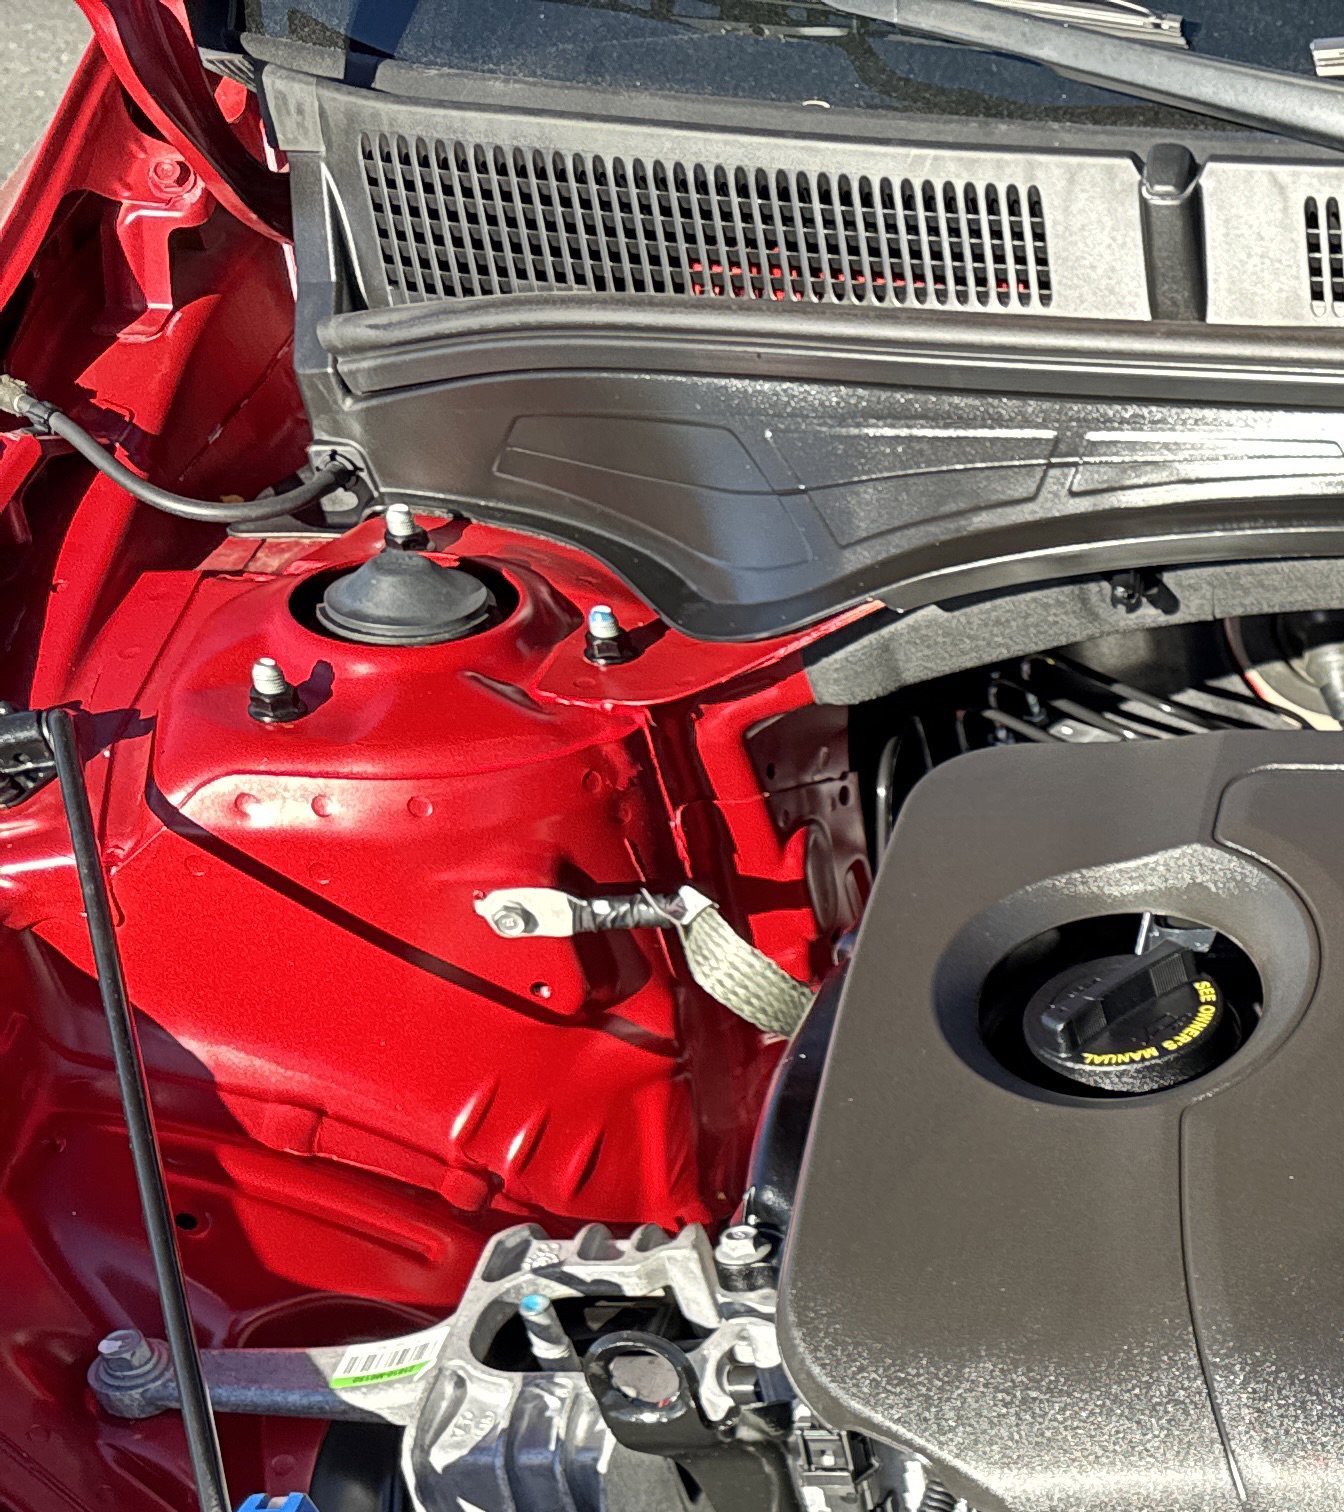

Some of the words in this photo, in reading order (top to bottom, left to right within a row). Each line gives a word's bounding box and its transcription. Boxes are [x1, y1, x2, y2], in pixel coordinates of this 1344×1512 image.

[1193, 980, 1217, 1003] SEE
[1161, 1004, 1216, 1050] OWNER'S
[1081, 1046, 1159, 1064] MANUAL
